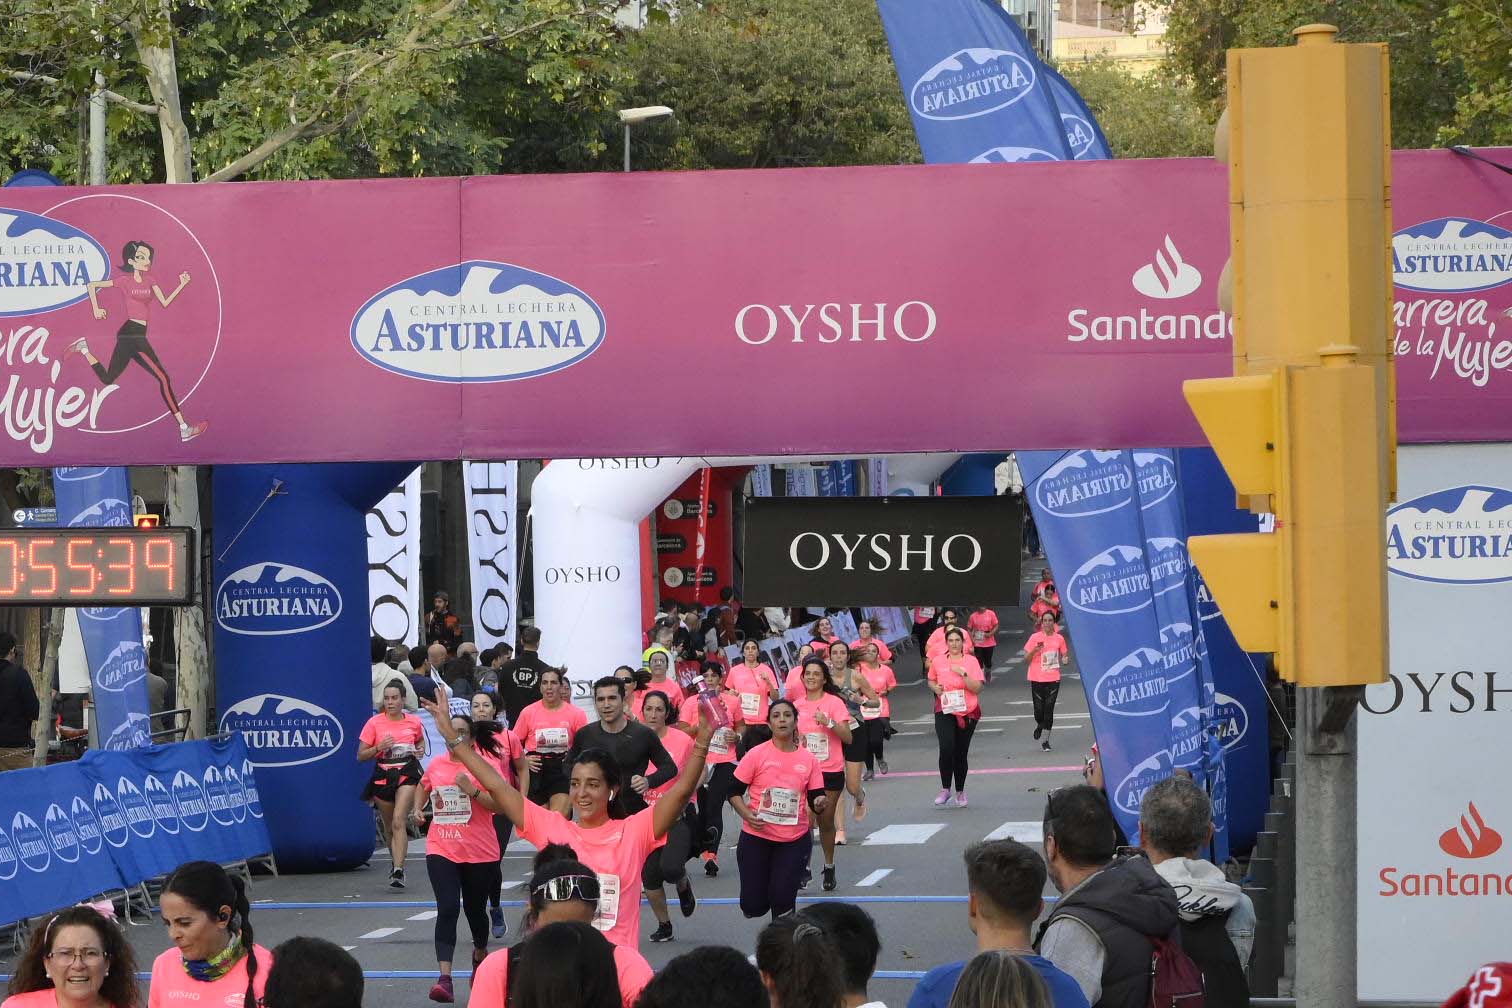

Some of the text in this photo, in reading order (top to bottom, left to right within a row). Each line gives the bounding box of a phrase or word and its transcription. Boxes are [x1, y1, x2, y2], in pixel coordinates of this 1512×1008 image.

[13, 244, 86, 255] LECHERA
[410, 301, 577, 317] CENTRAL LECHERA
[1392, 298, 1488, 327] arrera
[370, 307, 594, 353] ASTURIANA
[735, 301, 937, 345] OYSHO
[1416, 325, 1433, 356] la
[1414, 519, 1481, 530] CENTRAL
[789, 531, 982, 574] OYSHO
[545, 565, 620, 584] OYSHO
[233, 586, 328, 596] CENTRAL LECHERA
[220, 592, 334, 619] ASTURIANA
[519, 671, 532, 681] BP
[280, 718, 329, 727] LECHERA
